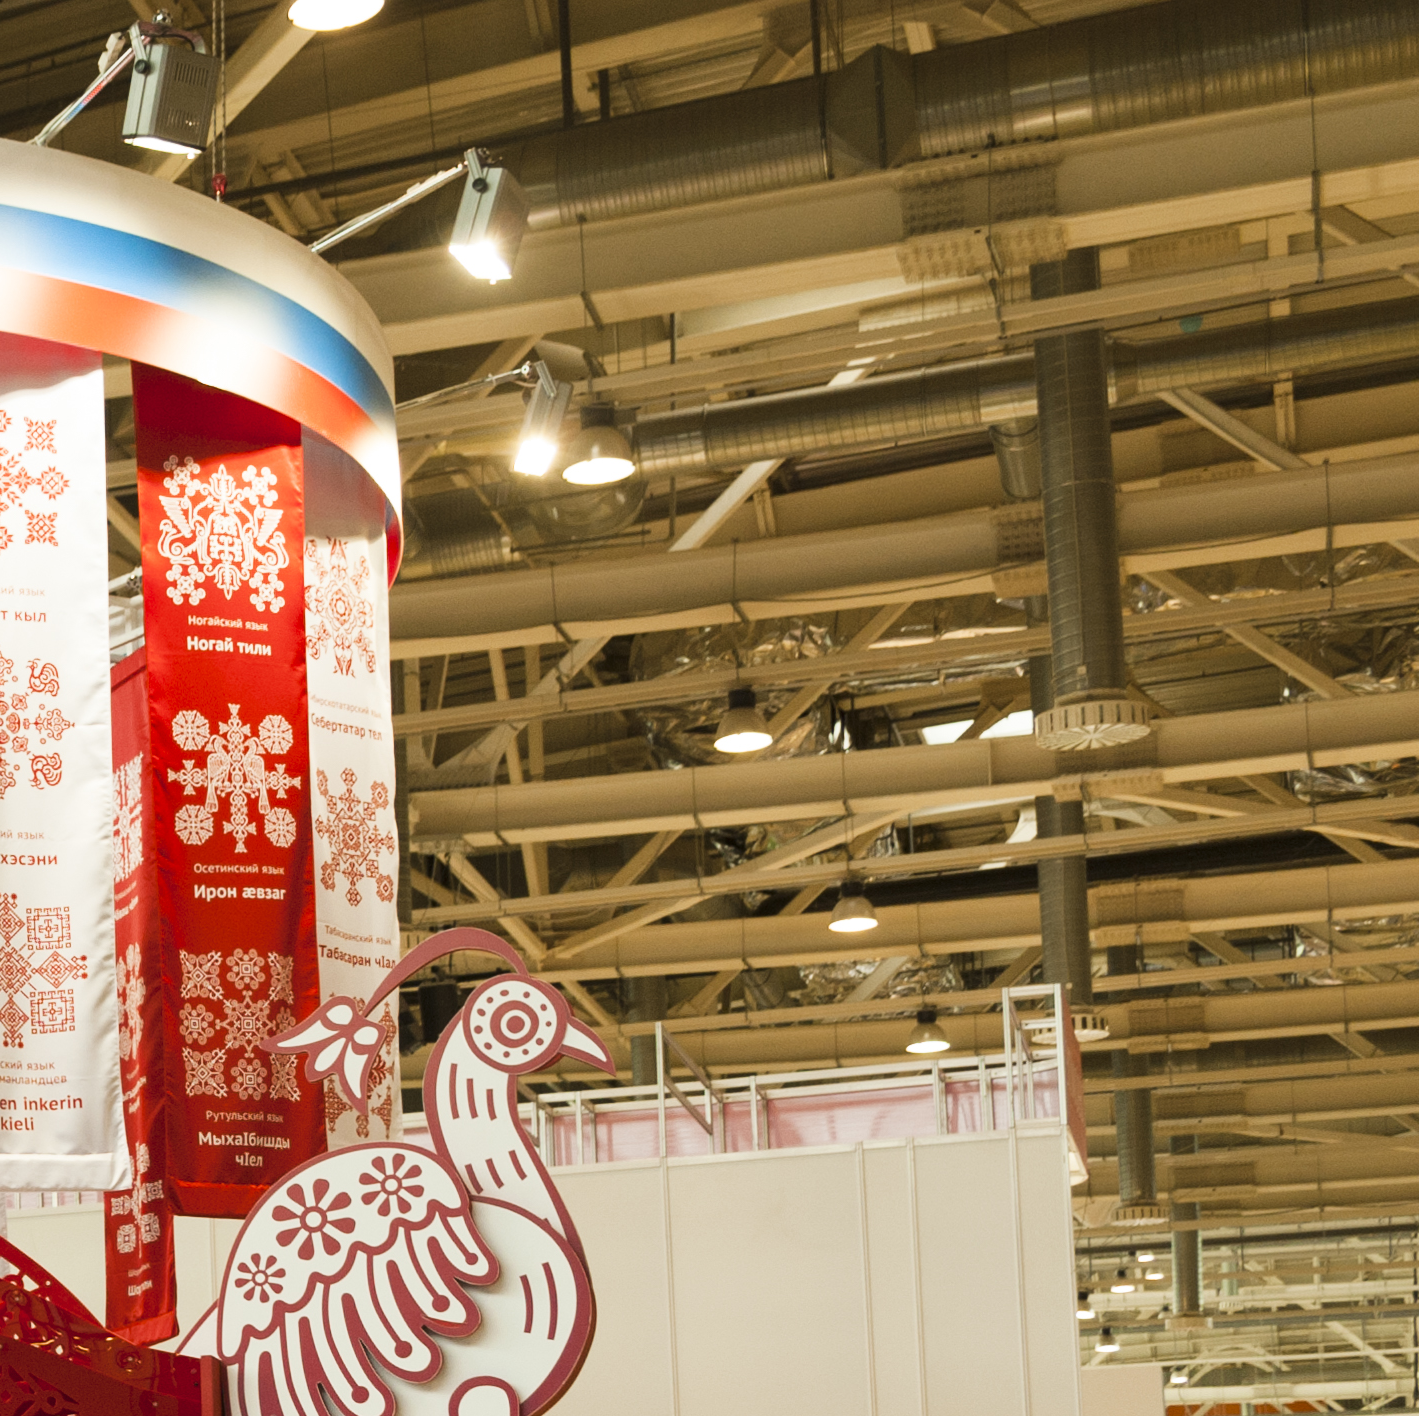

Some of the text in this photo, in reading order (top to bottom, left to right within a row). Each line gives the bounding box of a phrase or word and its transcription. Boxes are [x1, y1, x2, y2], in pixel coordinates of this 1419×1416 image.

[19, 588, 45, 597] язык
[14, 611, 47, 623] кыл
[188, 615, 269, 631] Ногайский язык
[187, 636, 272, 656] Ногай тили
[311, 711, 367, 739] Себертатар
[17, 831, 45, 841] язык
[0, 854, 58, 866] хэсэни
[193, 862, 285, 876] Осетинский язык
[194, 884, 238, 903] Ирон
[319, 944, 371, 967] Табасаран
[27, 1061, 55, 1071] язык
[23, 1094, 84, 1111] inkerin
[206, 1109, 284, 1123] Рутульский язык
[0, 1116, 35, 1132] kieli
